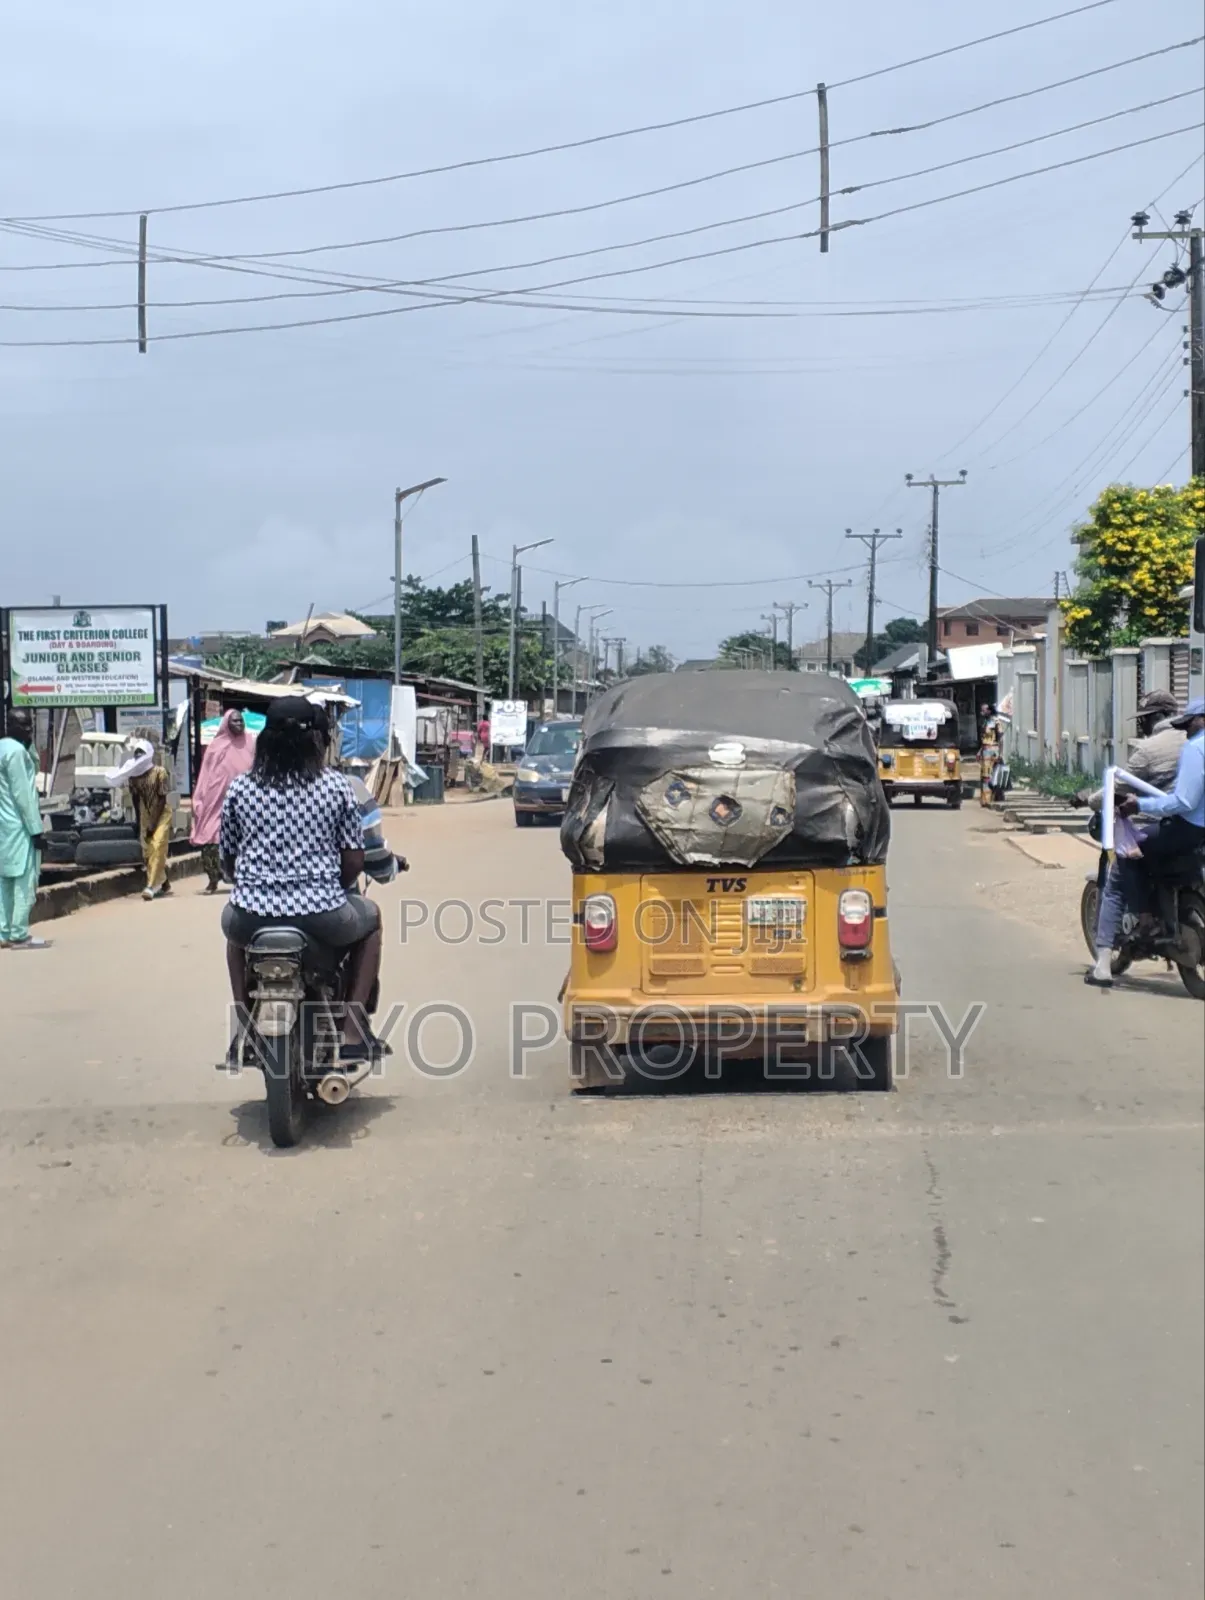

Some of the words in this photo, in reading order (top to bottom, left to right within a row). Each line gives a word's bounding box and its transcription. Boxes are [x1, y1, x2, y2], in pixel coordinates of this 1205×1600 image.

[18, 630, 34, 641] THE
[36, 630, 61, 641] FIRST
[63, 629, 110, 640] CRITERION
[112, 628, 148, 639] COLLEGE
[49, 642, 66, 650] (DAY
[22, 652, 67, 663] JUNIOR
[71, 651, 95, 662] AND
[98, 651, 142, 662] SENIOR
[57, 662, 109, 673] CLASSES
[492, 700, 526, 713] POS
[706, 877, 747, 893] TVS
